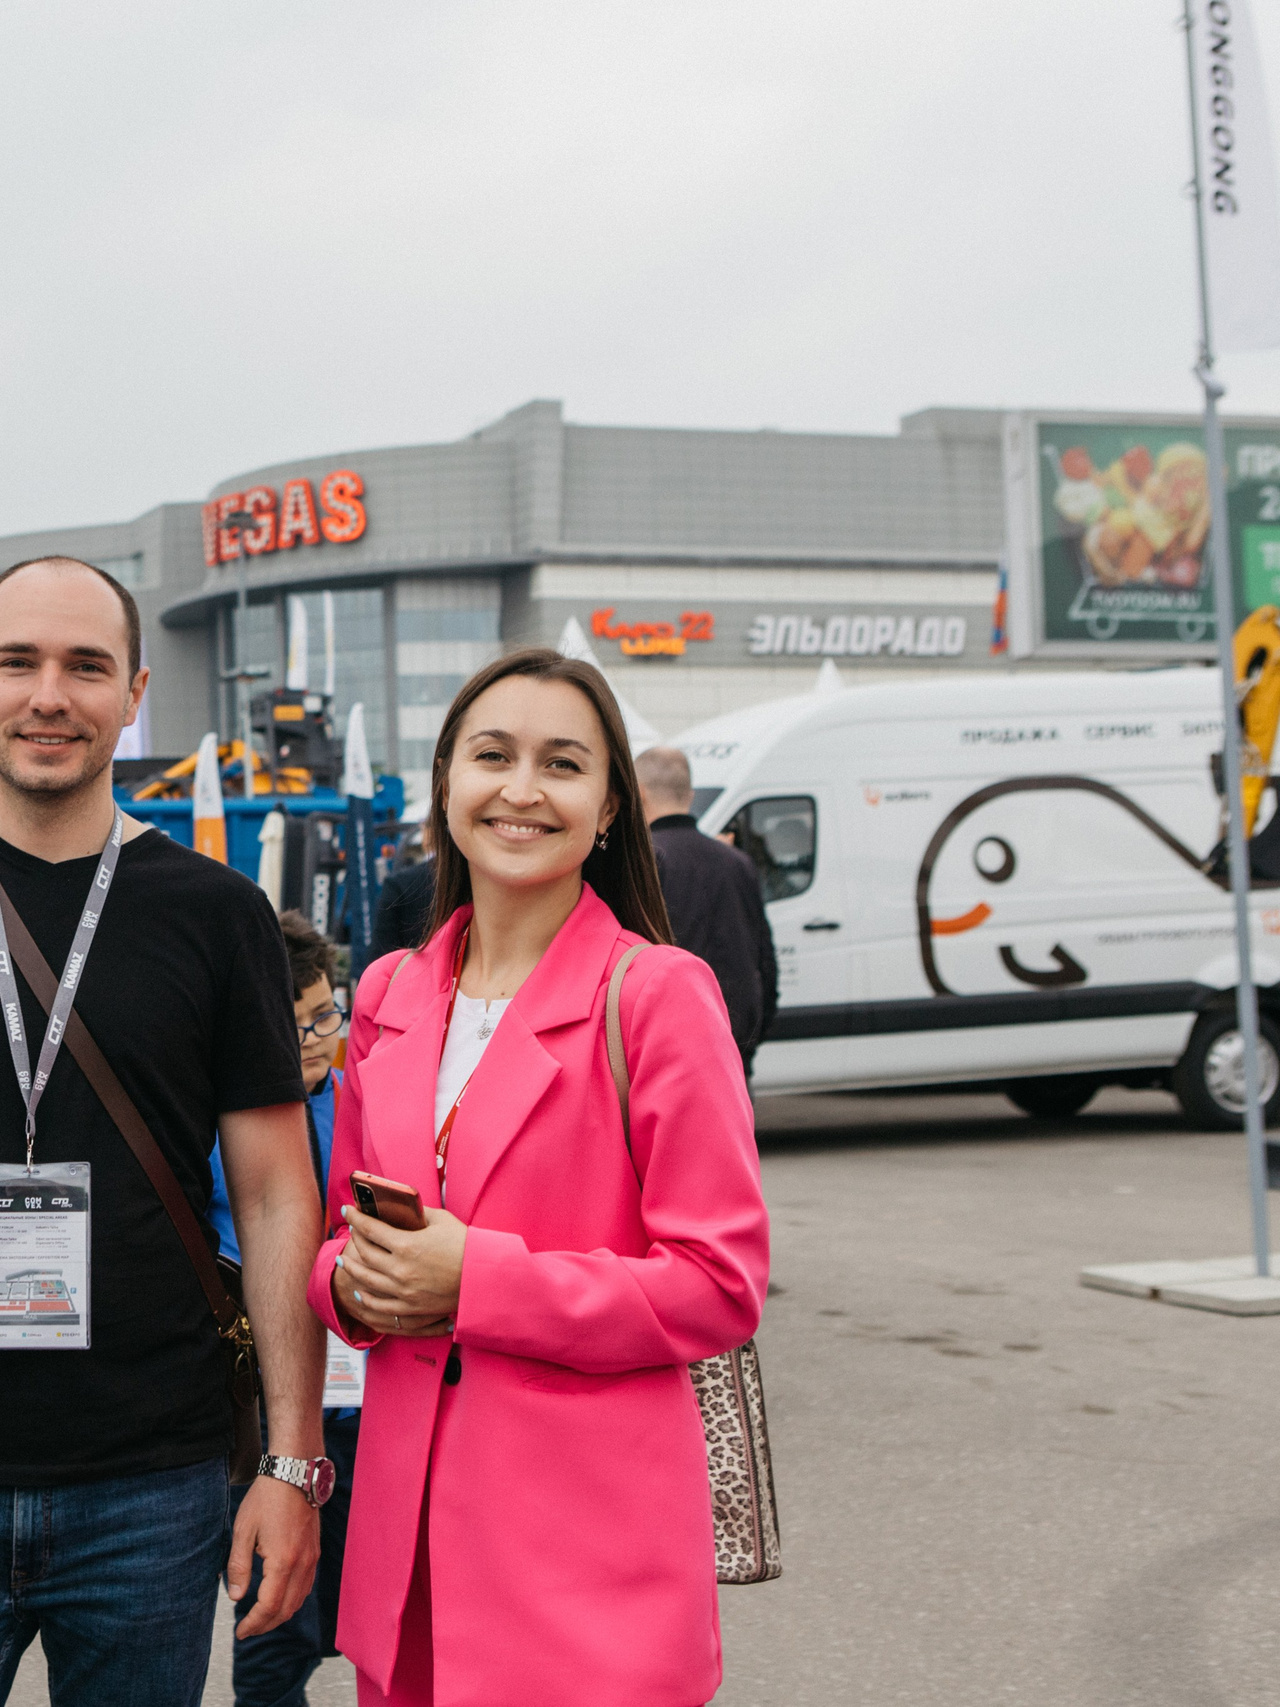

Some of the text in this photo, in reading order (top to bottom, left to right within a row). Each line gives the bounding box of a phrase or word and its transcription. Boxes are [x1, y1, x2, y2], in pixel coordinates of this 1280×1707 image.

[201, 469, 368, 567] VEGAS
[747, 614, 967, 657] ЭЛЬДОРАДО
[63, 952, 84, 989] KAMAZ
[5, 1002, 22, 1042] KAMAZ
